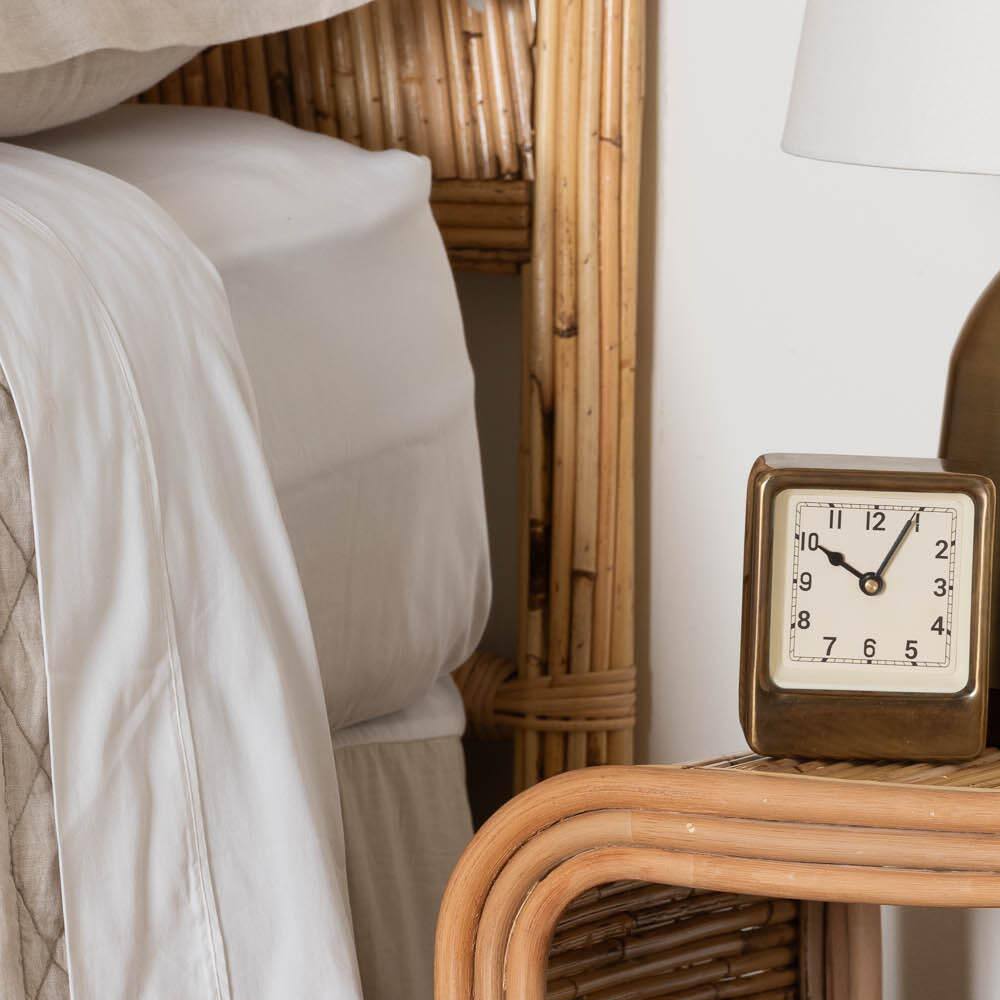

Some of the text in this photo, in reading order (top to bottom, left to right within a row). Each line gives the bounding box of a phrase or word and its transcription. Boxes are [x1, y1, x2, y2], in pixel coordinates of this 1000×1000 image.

[829, 510, 842, 529] 11
[866, 511, 886, 531] 12
[801, 531, 819, 551] 10
[935, 540, 949, 560] 2
[799, 572, 812, 591] 9
[933, 578, 947, 597] 3
[797, 610, 810, 629] 8
[931, 616, 945, 635] 4
[823, 636, 837, 656] 7
[863, 638, 877, 658] 6
[905, 640, 918, 659] 5
